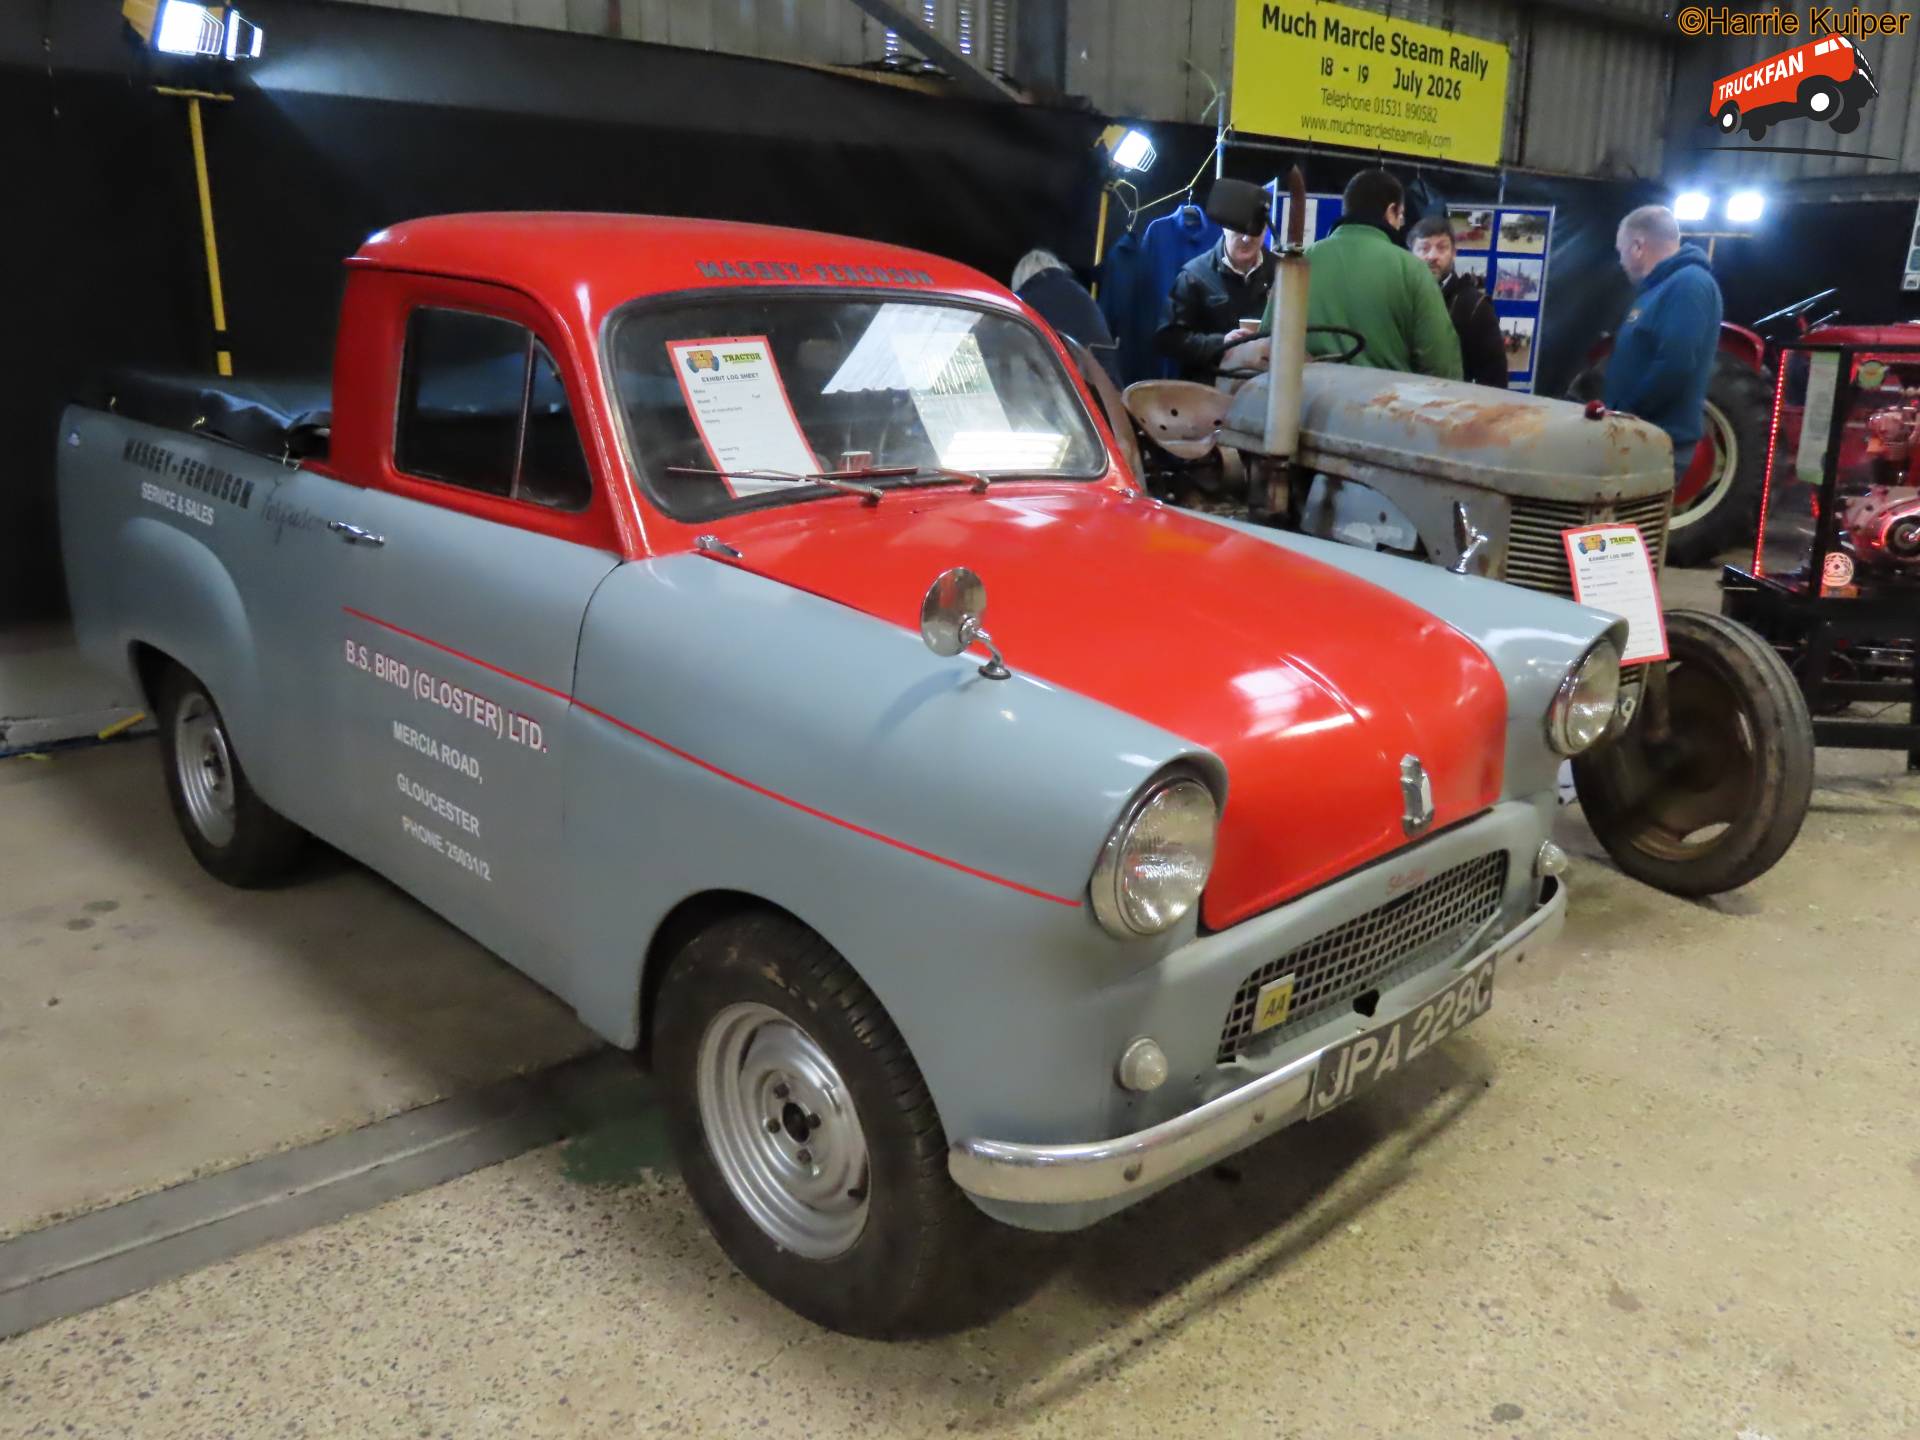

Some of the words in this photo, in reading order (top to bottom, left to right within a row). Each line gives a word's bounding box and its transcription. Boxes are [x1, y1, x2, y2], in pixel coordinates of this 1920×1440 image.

[1261, 3, 1317, 39] Much
[1323, 17, 1386, 53] Marcle
[1390, 32, 1444, 66] Steam
[1450, 46, 1489, 81] Rally
[1320, 56, 1334, 77] 18
[1357, 64, 1369, 83] 19
[1392, 67, 1423, 99] July
[1427, 74, 1462, 101] 2026
[1321, 88, 1371, 112] Telephone
[1373, 97, 1402, 118] 01531
[1300, 115, 1452, 148] www.muchmarclesteamrally.com
[722, 352, 762, 363] TRACTOR
[142, 481, 176, 511] SERVICE
[184, 498, 215, 526] SALES
[346, 639, 372, 673] B.S.
[375, 652, 411, 689] BIRD
[413, 669, 504, 740] (GLOSTER)
[508, 713, 549, 754] LTD.
[393, 720, 440, 761] MERCIA
[441, 744, 484, 785] ROAD,
[397, 772, 481, 838] GLOUCESTER
[402, 815, 445, 854] PHONE
[1317, 1023, 1401, 1108] JPA
[1405, 962, 1493, 1062] 228C
